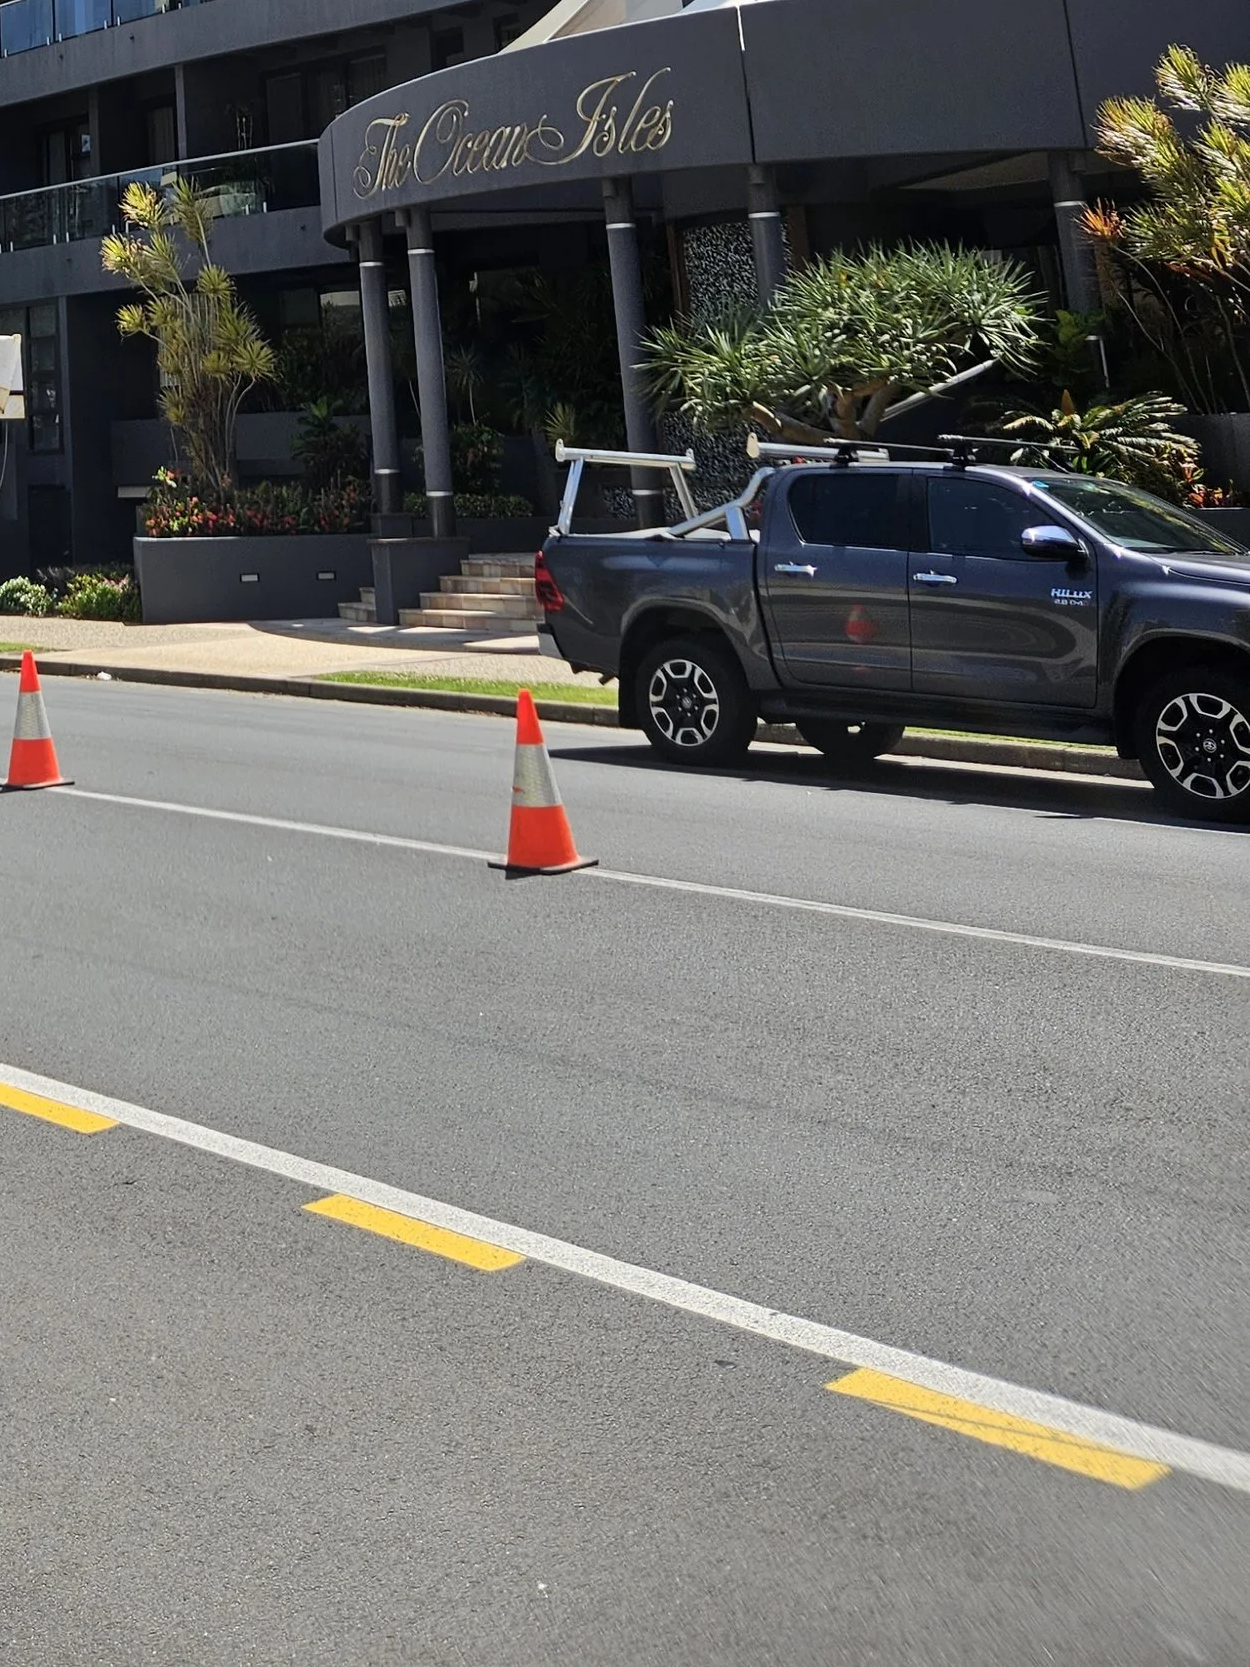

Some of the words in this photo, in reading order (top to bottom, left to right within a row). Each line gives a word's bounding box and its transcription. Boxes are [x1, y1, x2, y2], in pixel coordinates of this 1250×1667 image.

[353, 112, 412, 199] The
[414, 100, 527, 184] Ocean
[525, 67, 674, 165] Isles
[1050, 588, 1093, 599] HILUX
